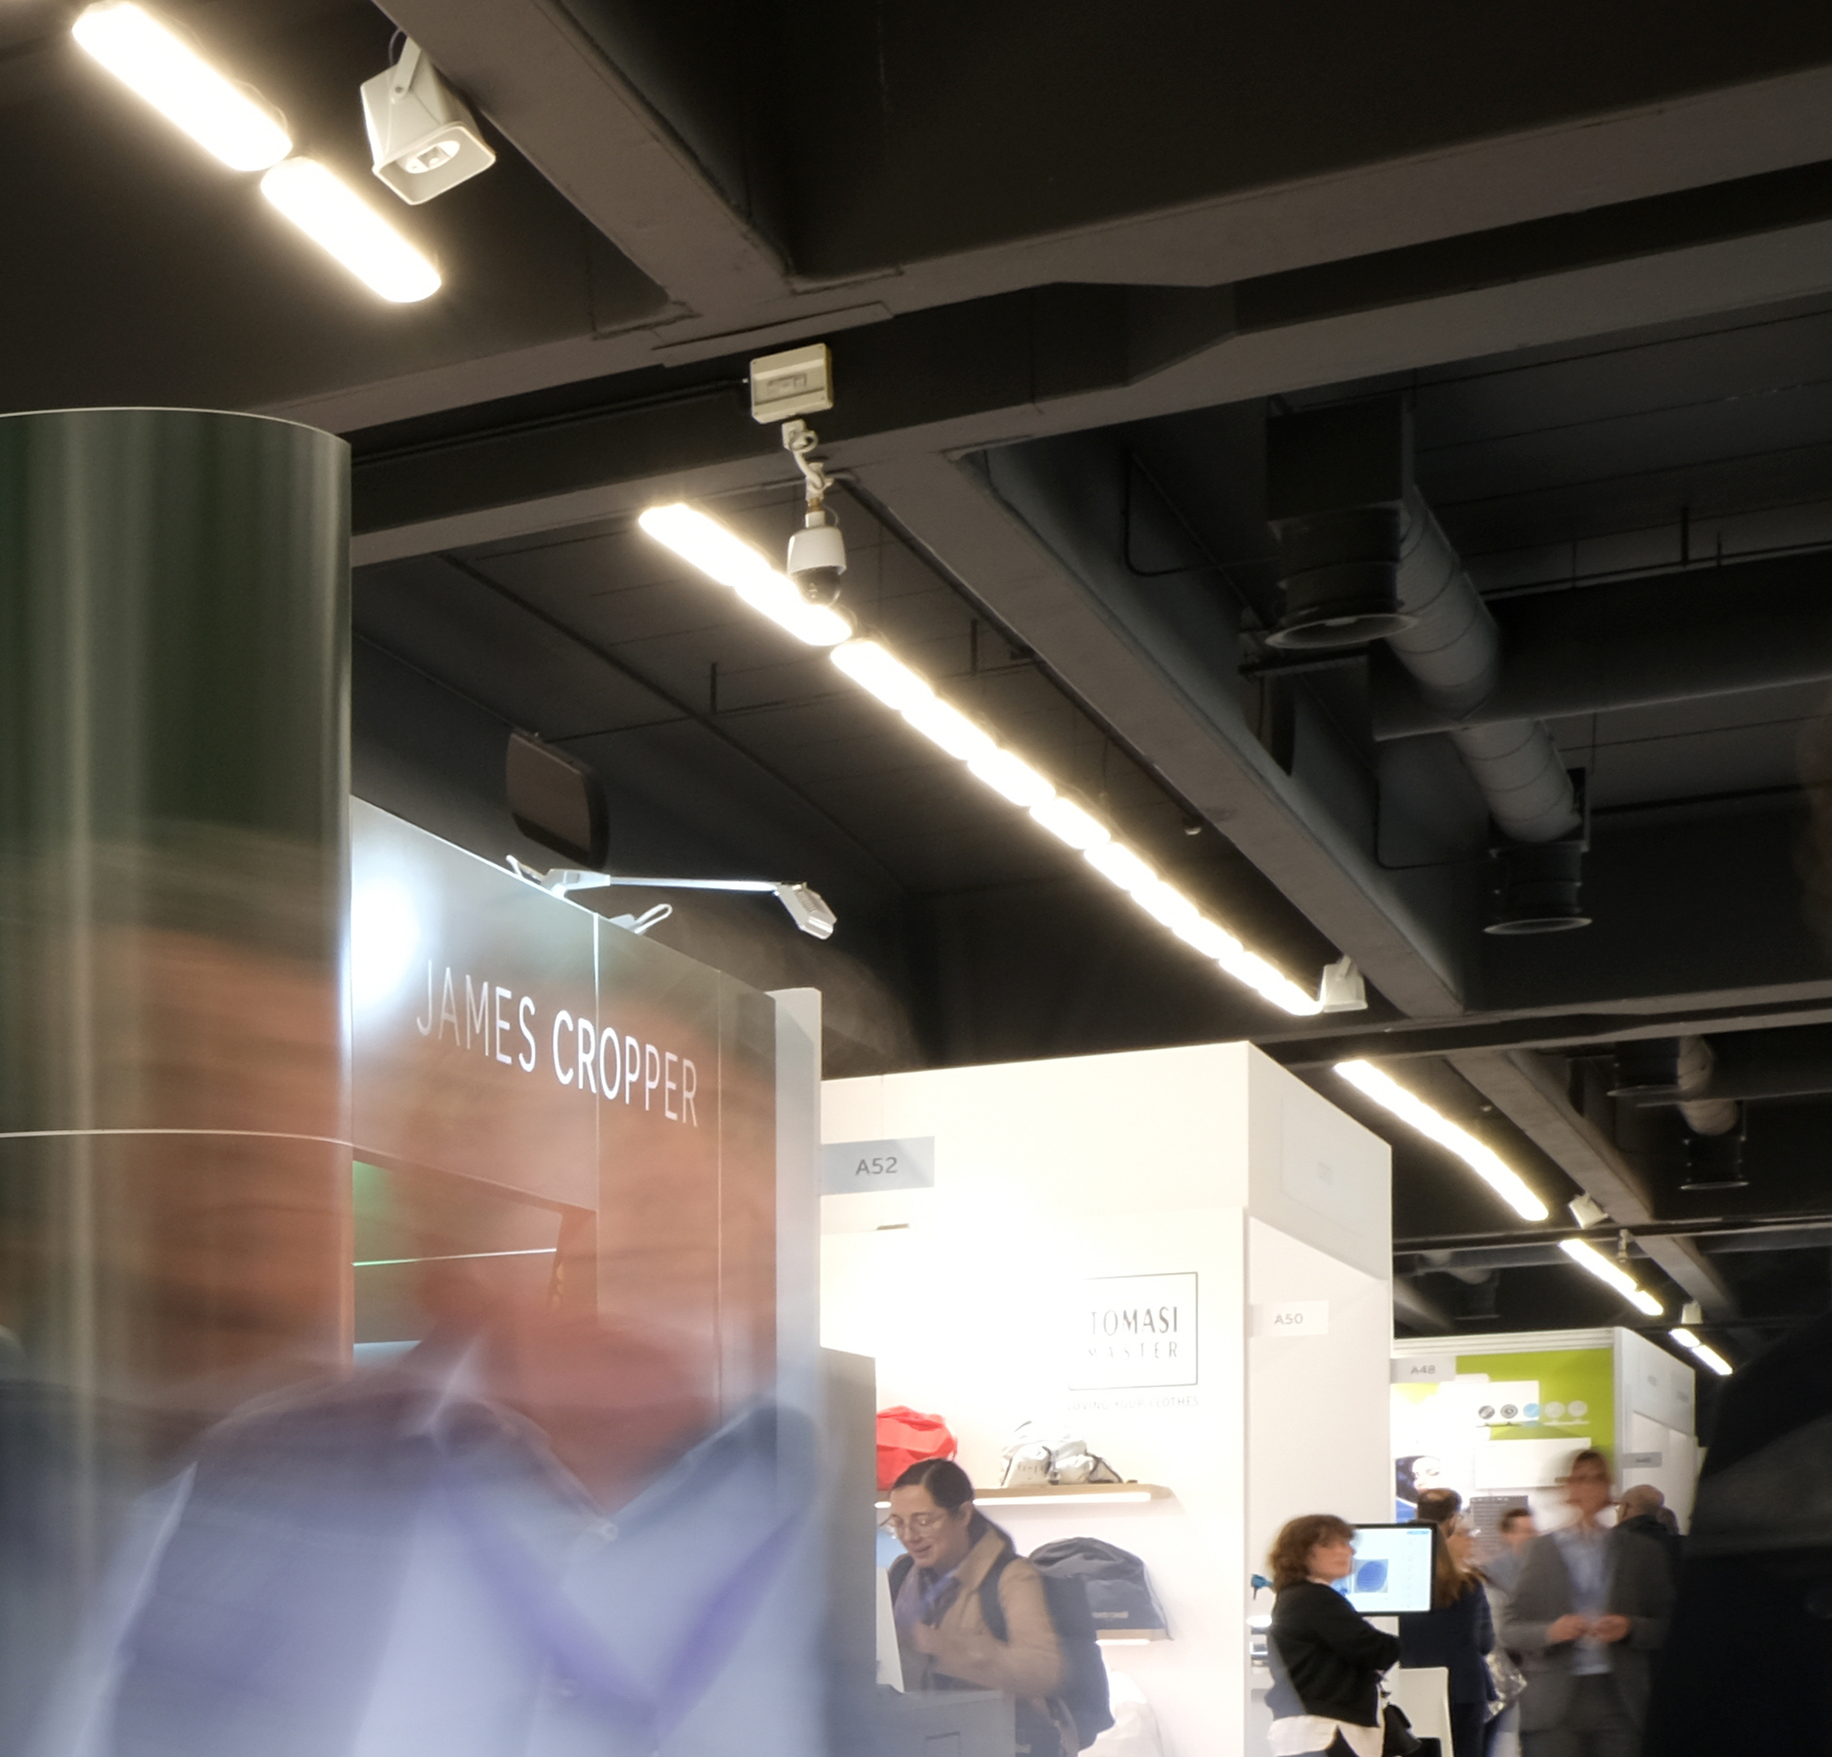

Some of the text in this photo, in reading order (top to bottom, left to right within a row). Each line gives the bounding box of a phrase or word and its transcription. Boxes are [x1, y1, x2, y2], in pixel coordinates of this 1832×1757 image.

[416, 959, 698, 1128] JAMES CROPPER
[855, 1156, 898, 1176] A52
[1090, 1306, 1178, 1336] TOMASI
[1274, 1313, 1304, 1325] A50
